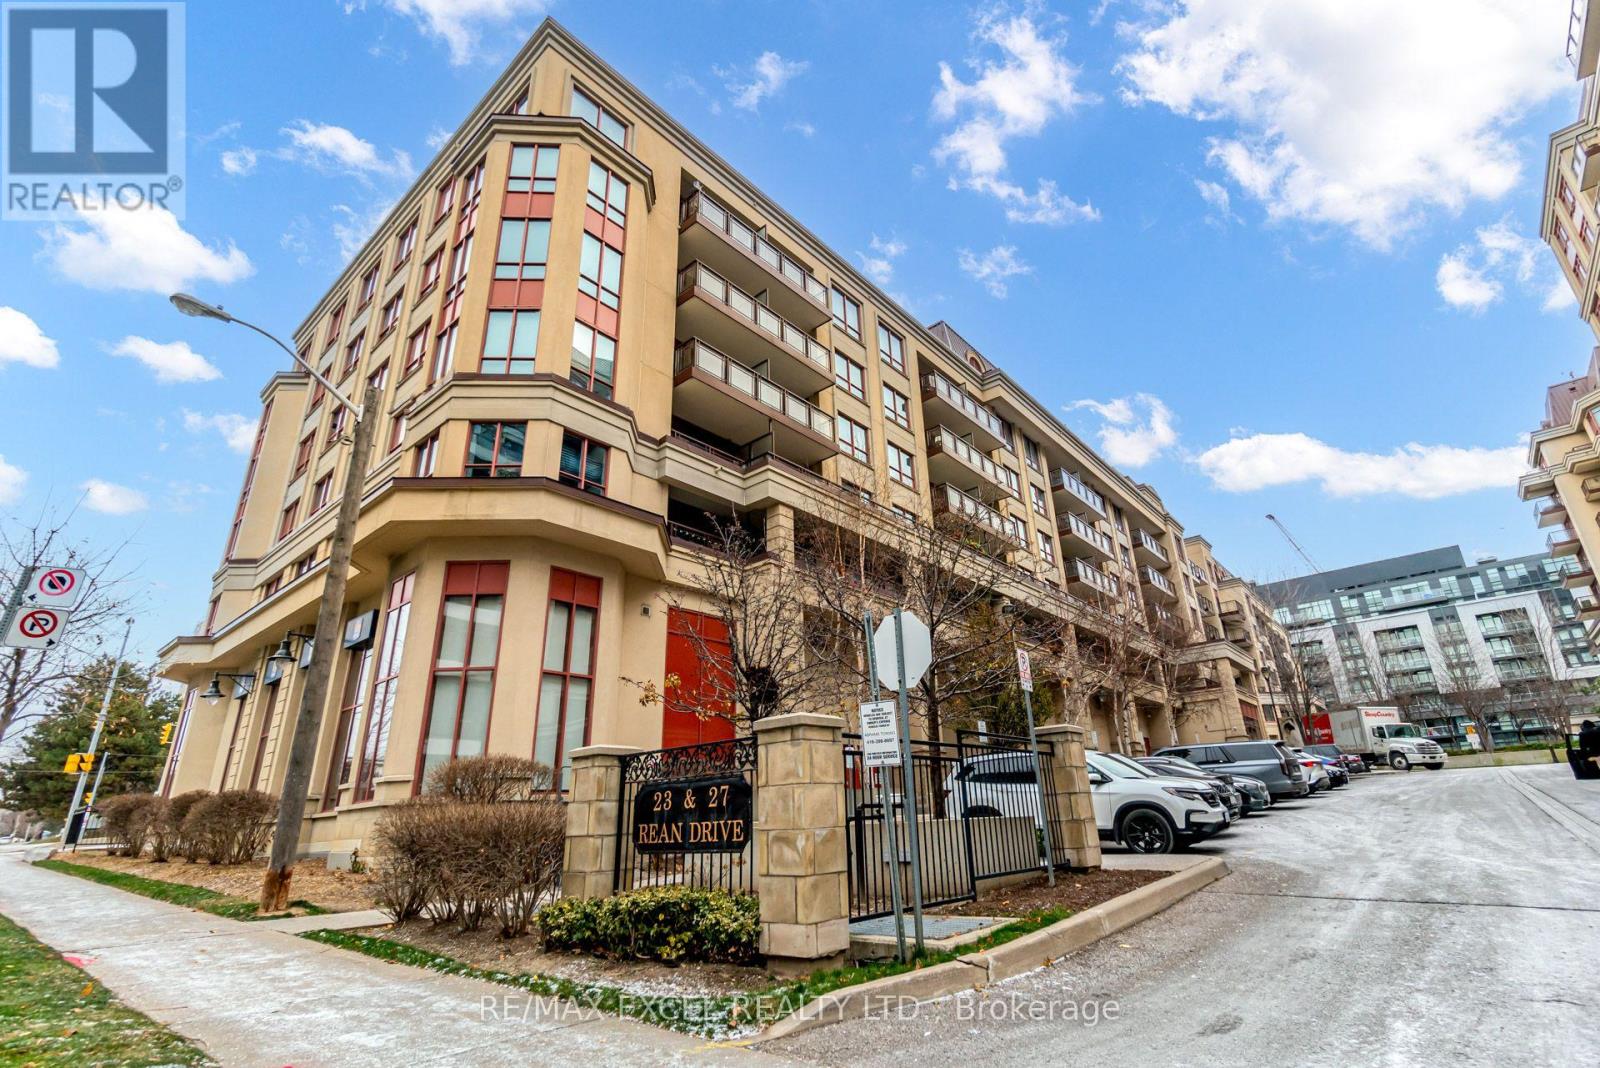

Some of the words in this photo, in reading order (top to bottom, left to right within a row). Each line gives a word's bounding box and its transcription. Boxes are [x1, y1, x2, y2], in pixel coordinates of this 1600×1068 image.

[653, 790, 672, 812] 23
[684, 788, 696, 809] &
[708, 785, 729, 807] 27
[638, 822, 682, 844] REAN
[689, 819, 744, 843] DRIVE
